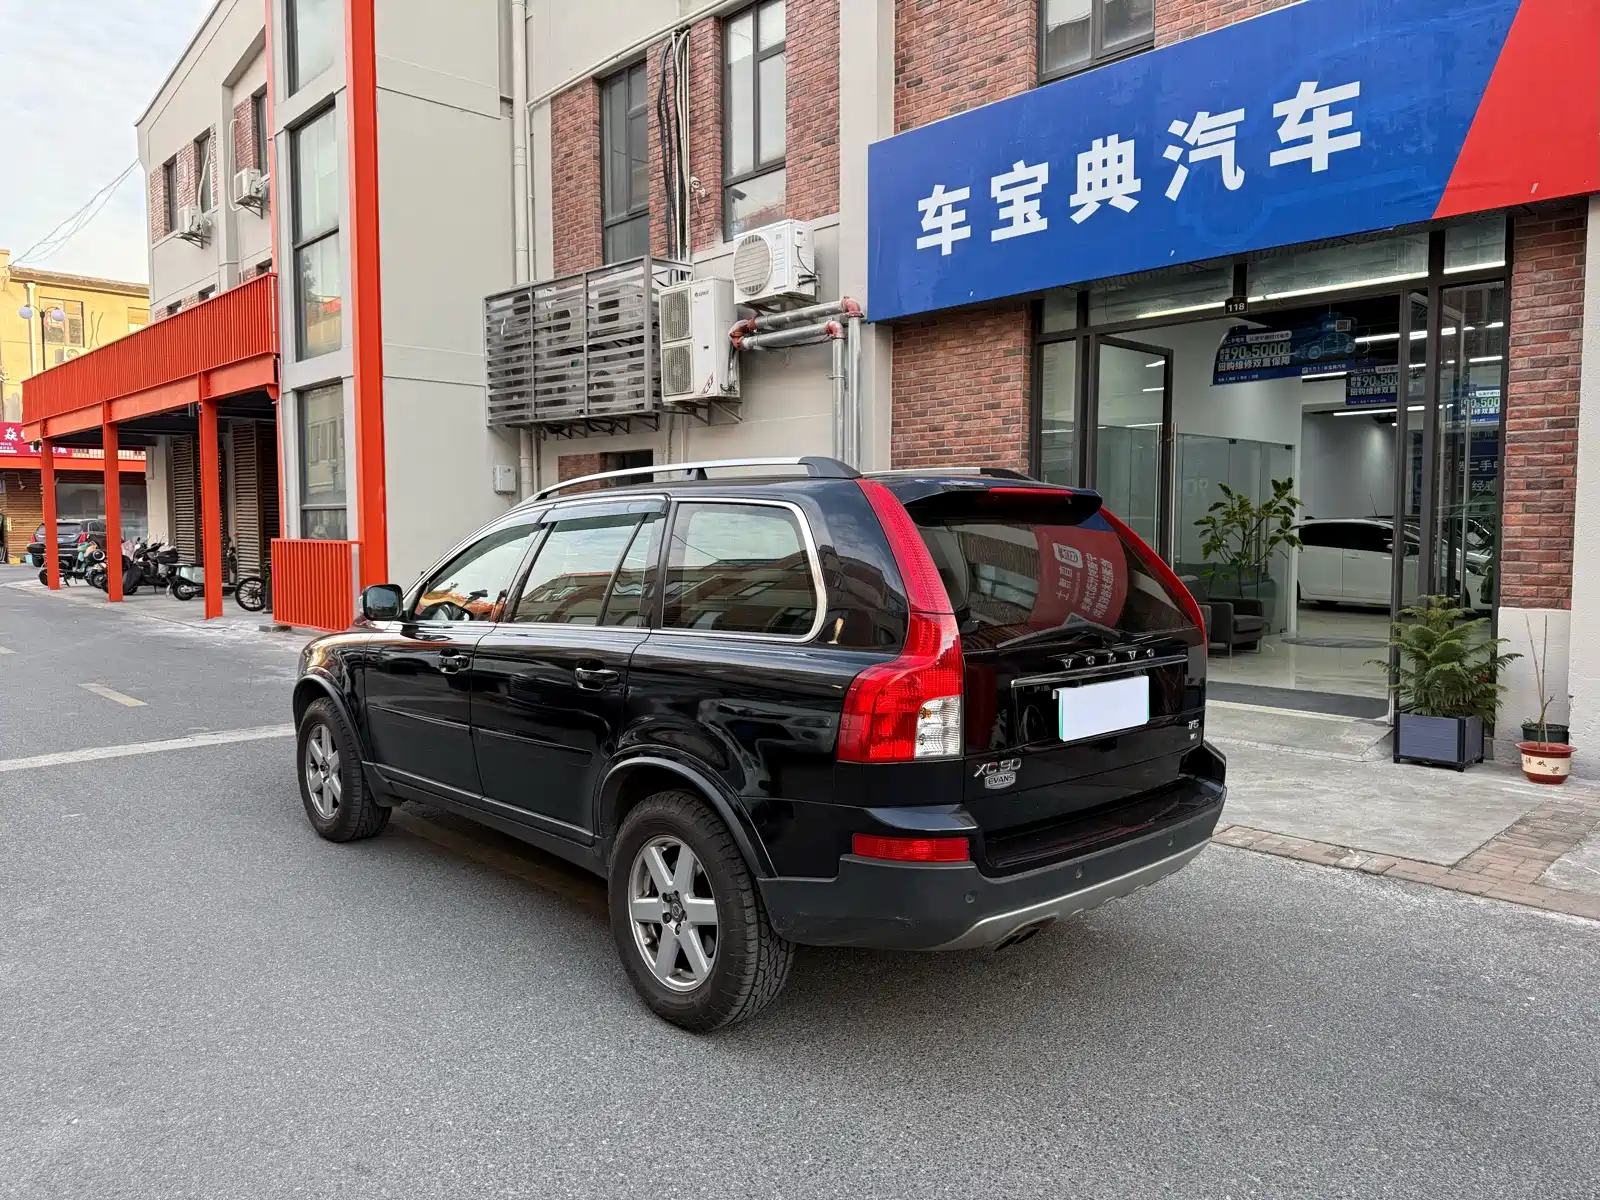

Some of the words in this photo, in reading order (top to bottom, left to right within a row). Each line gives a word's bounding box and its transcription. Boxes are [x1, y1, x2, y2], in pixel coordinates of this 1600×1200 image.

[916, 81, 1361, 257] 车宝典汽车
[1228, 303, 1245, 312] 118
[1217, 356, 1291, 372] 回购维修双重保障
[1060, 648, 1156, 669] VOLVO
[973, 757, 1022, 777] XC90
[988, 774, 1014, 785] EVANS
